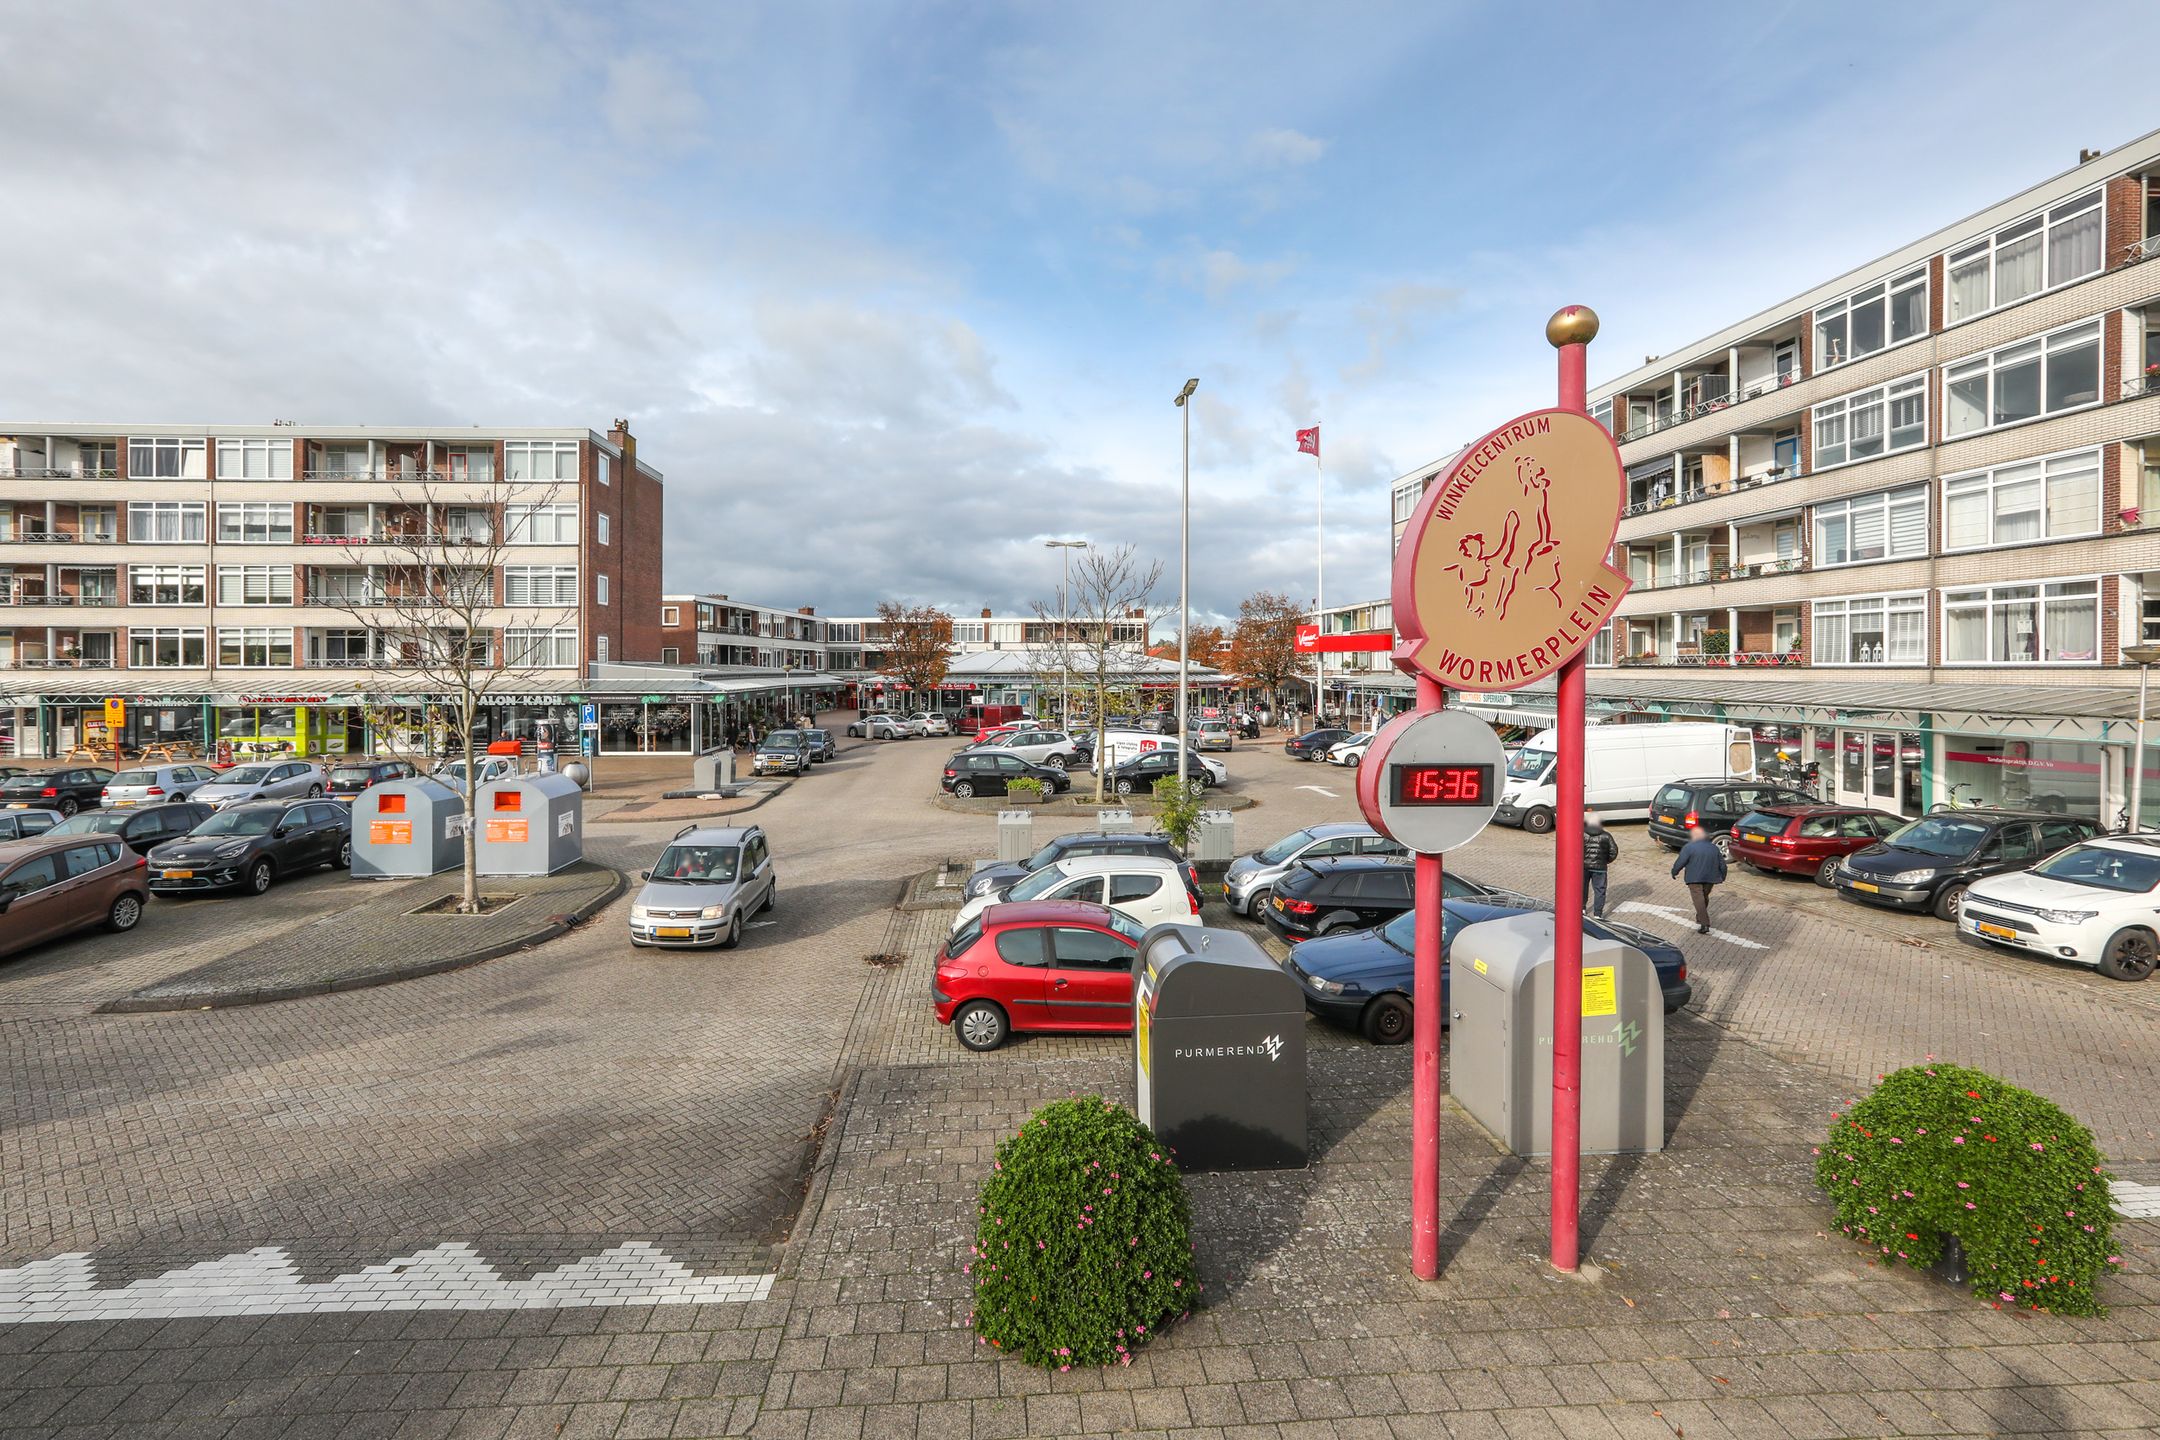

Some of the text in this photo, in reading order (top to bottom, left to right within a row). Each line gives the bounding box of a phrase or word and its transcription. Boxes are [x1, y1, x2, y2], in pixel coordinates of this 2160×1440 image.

[1436, 416, 1551, 521] WINKELCENTRUM
[1438, 584, 1612, 683] WORMERPLEIN
[441, 695, 516, 706] KAALON
[584, 706, 592, 716] P
[1414, 770, 1479, 799] 15:36
[1538, 1035, 1614, 1046] PUREND
[1175, 1045, 1265, 1058] PURMEREND
